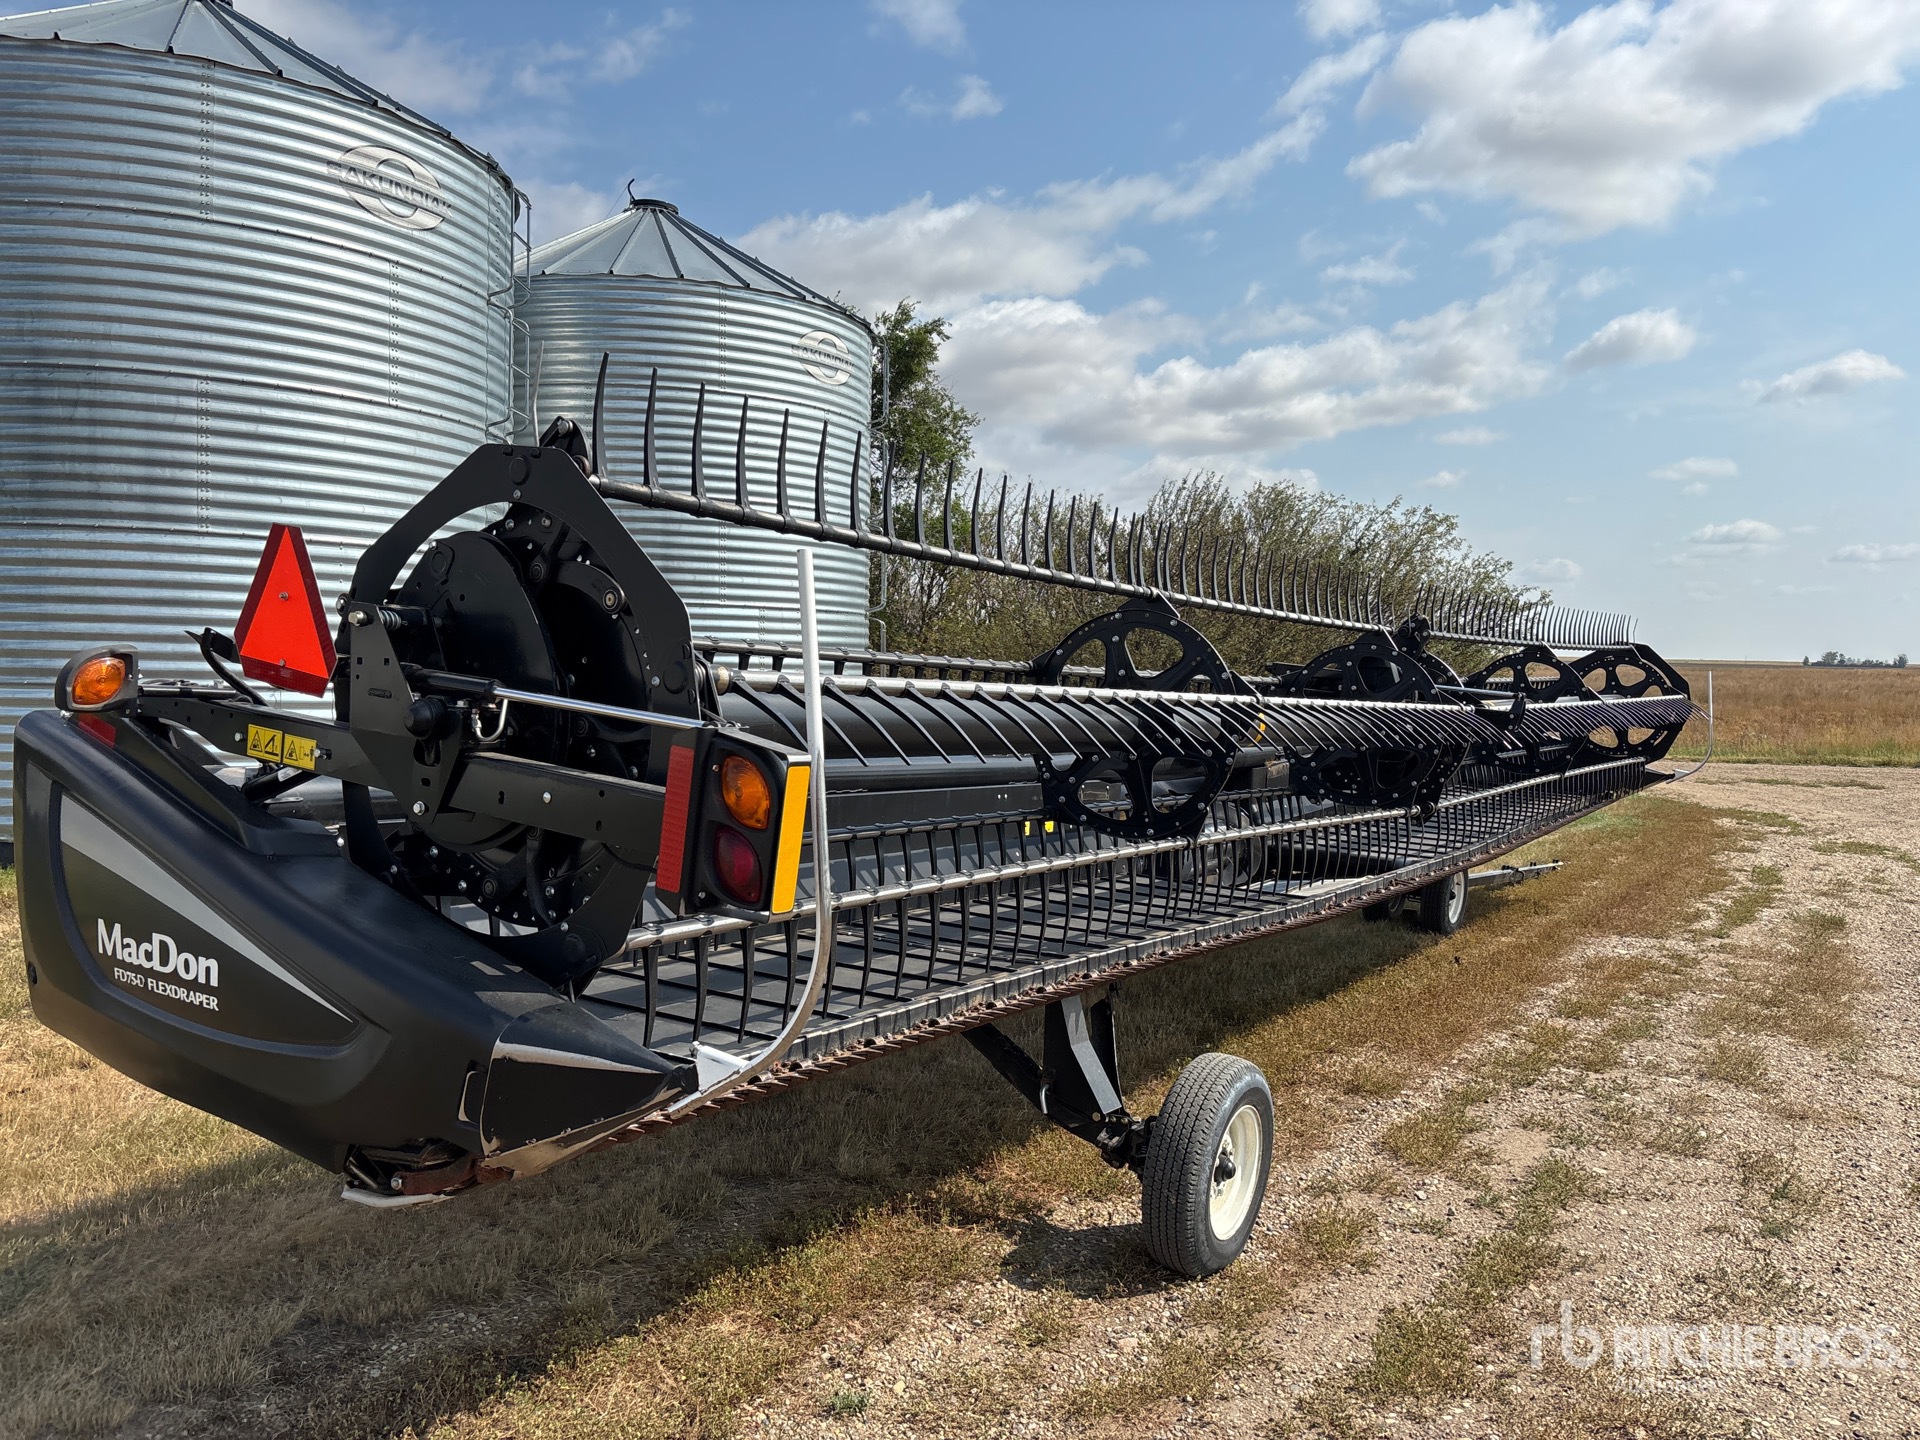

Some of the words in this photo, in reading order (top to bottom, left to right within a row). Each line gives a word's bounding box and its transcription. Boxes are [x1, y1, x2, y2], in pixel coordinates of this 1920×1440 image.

[326, 160, 453, 218] SAKUNDIAK
[97, 917, 219, 988] MacDon
[146, 977, 220, 1012] FLEXDRAPER
